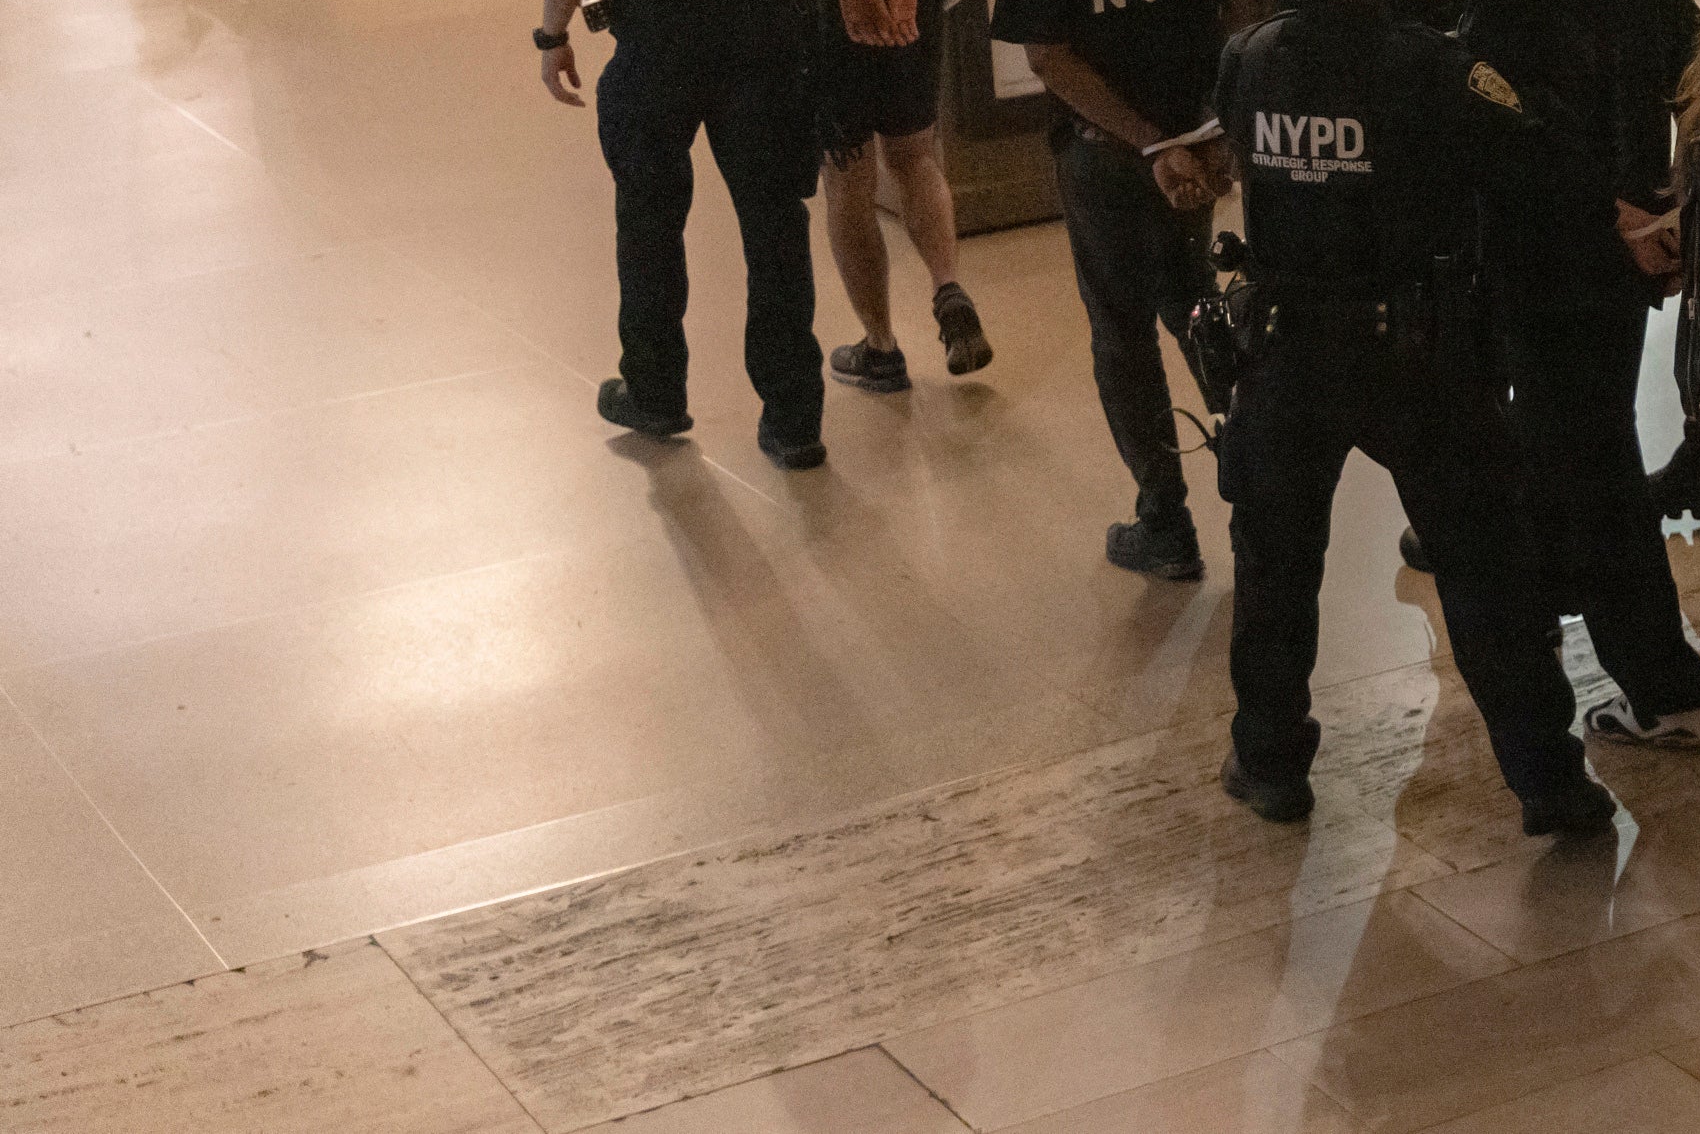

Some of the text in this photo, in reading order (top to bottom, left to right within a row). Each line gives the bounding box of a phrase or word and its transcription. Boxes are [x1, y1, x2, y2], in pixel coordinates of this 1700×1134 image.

[1255, 110, 1365, 159] NYPD
[1252, 152, 1374, 173] STRATEGIC RESPONSE
[1290, 169, 1329, 183] GROUP
